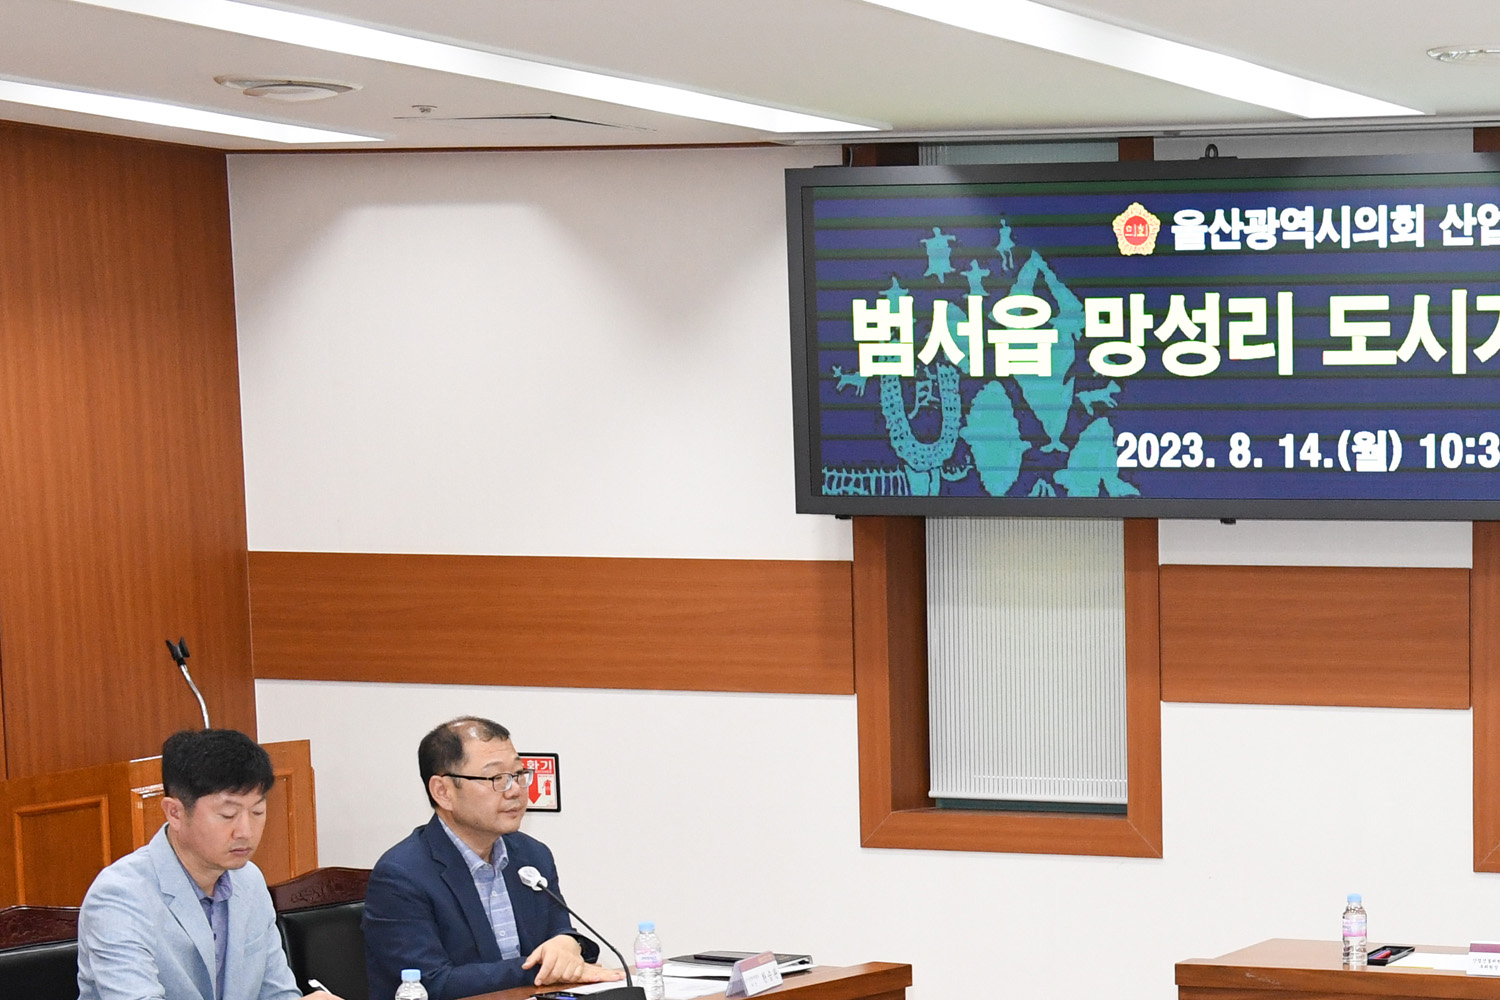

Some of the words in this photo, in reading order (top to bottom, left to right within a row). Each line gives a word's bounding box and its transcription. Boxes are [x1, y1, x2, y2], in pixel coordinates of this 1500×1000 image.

[1171, 203, 1425, 251] 울산광역시의회
[852, 294, 1059, 377] 범서읍
[1085, 291, 1293, 377] 망성리
[1115, 432, 1215, 469] 2023.
[1228, 432, 1263, 469] 8.
[1278, 429, 1402, 472] 14.(월)
[521, 759, 553, 771] 화기
